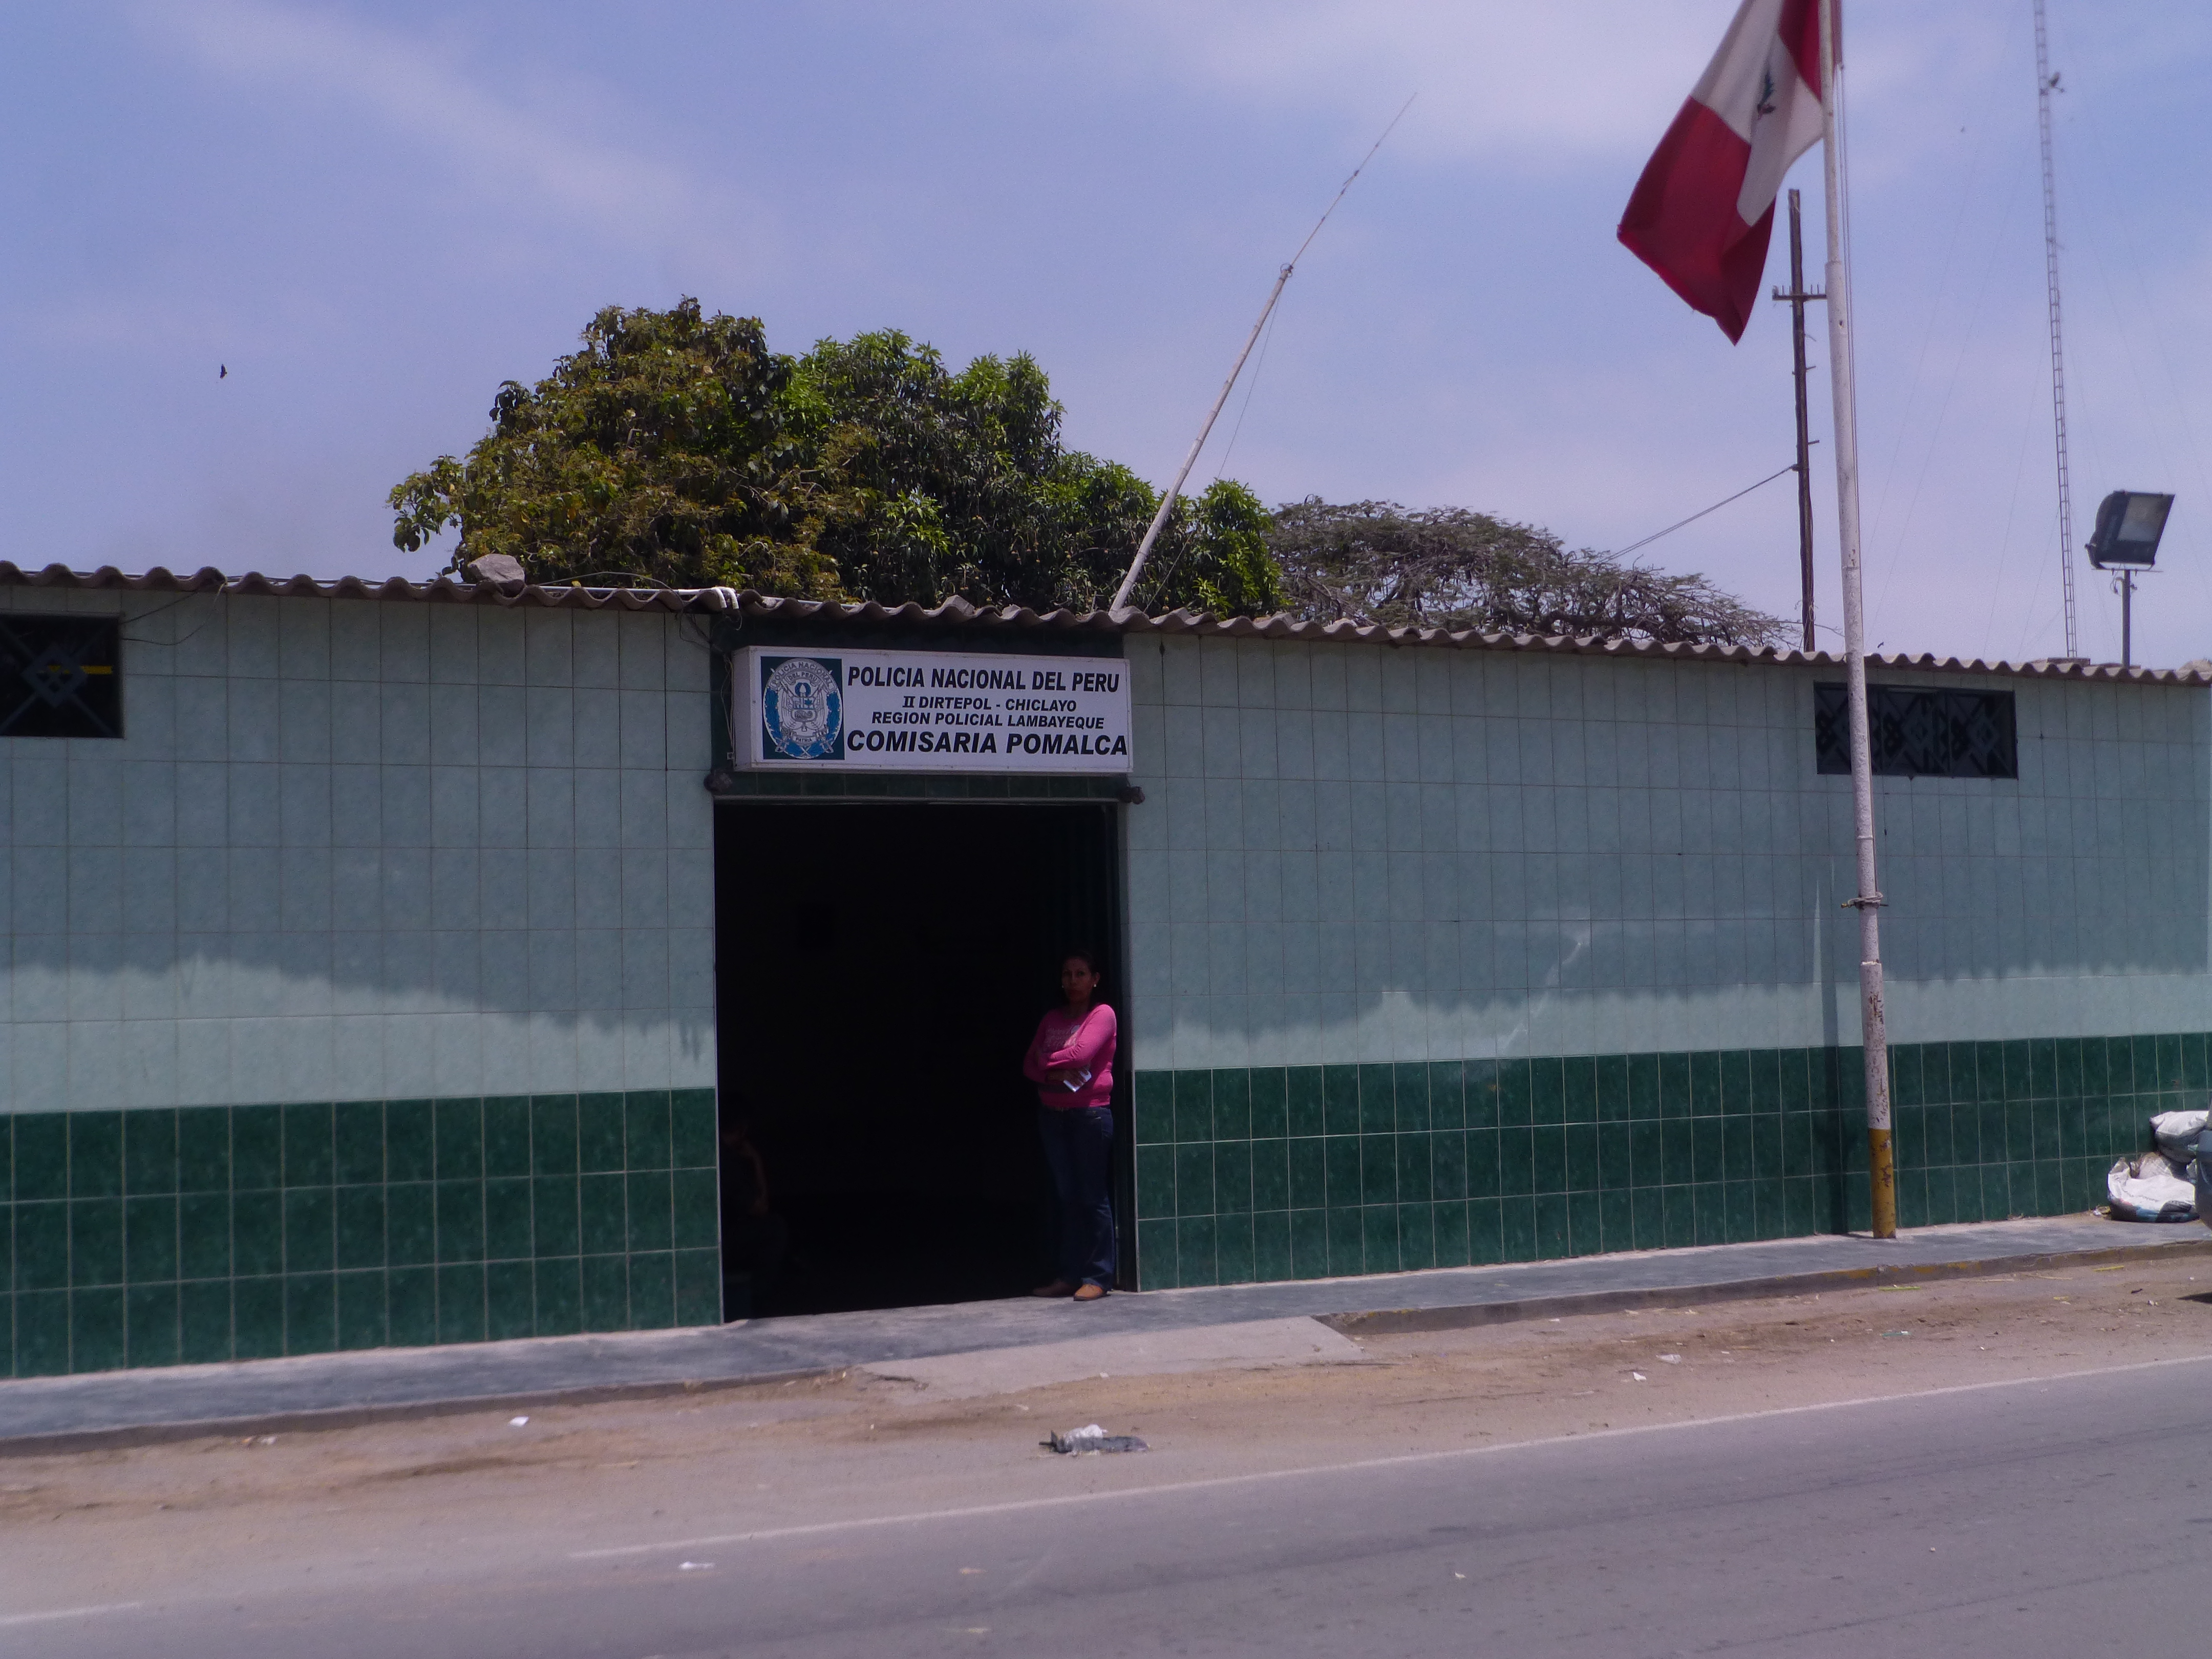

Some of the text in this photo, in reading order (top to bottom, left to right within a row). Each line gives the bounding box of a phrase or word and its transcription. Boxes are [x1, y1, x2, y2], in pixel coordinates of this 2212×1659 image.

[772, 662, 833, 688] POLICIA NACIONAL
[789, 672, 818, 682] DEL PERU
[848, 667, 1119, 693] POLICIA NACIONAL DEL PERU
[902, 696, 915, 708] II
[919, 696, 991, 710] DIRTEPOL
[1006, 699, 1076, 712] CHICLAYO
[871, 712, 1104, 729] REGION POLICIAL LAMBAYEQUE
[847, 730, 996, 753] COMISARIA
[1006, 733, 1128, 755] POMALCA
